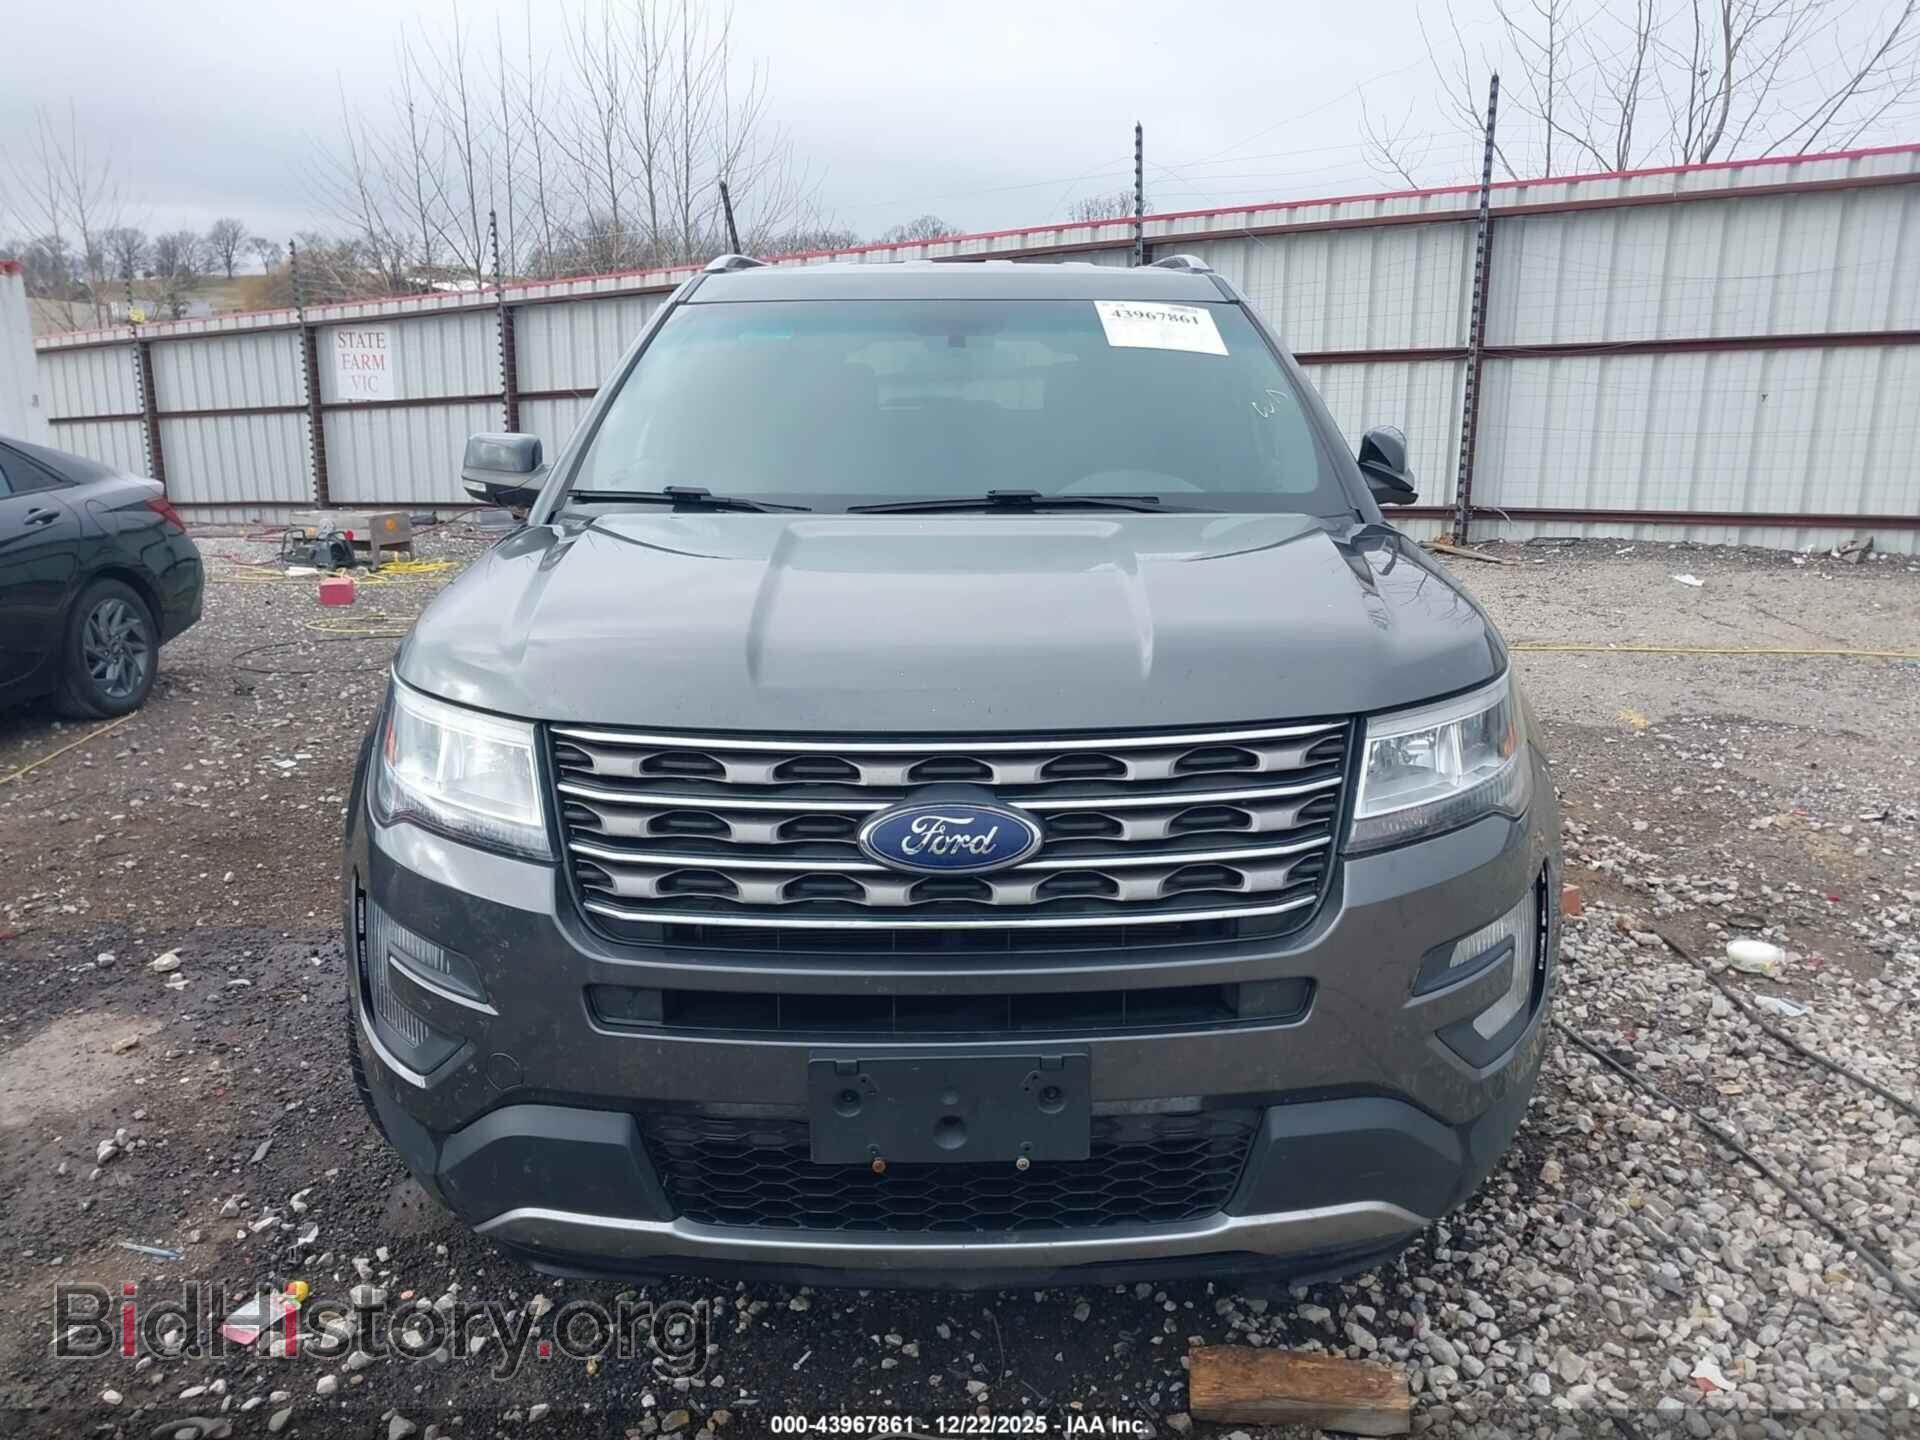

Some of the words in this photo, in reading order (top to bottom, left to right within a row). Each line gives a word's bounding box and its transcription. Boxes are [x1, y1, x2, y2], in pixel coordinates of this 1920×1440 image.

[1111, 309, 1200, 325] 43967861
[337, 331, 386, 349] STATE
[341, 352, 385, 370] FARM
[352, 375, 378, 392] VIC
[901, 815, 998, 855] Ford
